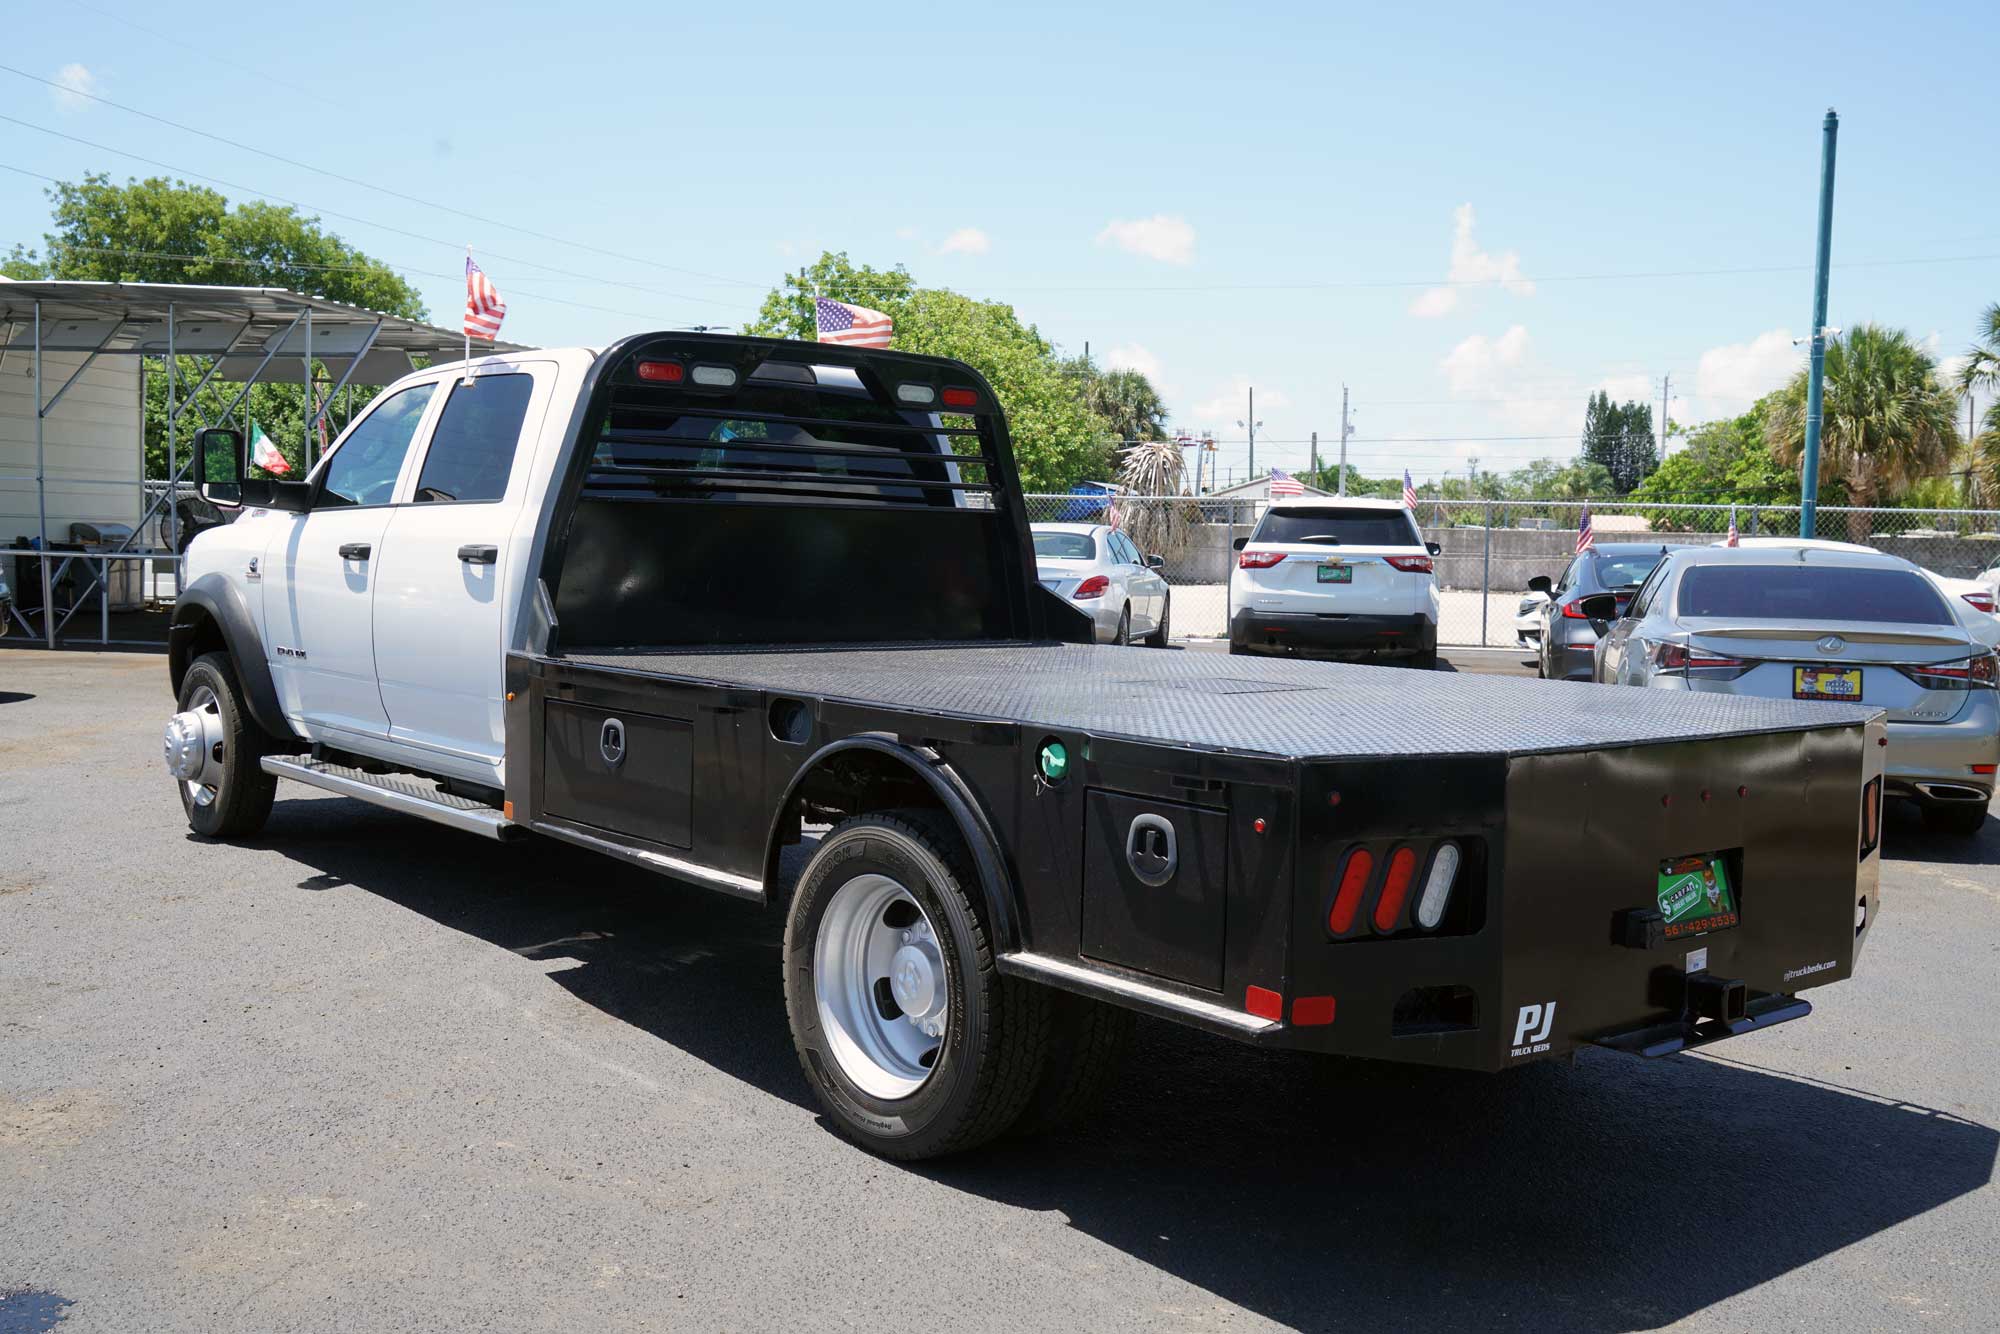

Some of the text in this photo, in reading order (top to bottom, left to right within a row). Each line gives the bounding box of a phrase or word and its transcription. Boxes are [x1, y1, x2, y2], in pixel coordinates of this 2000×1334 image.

[1512, 1001, 1557, 1046] PJ
[1511, 1043, 1551, 1057] TRUCK BEDS
